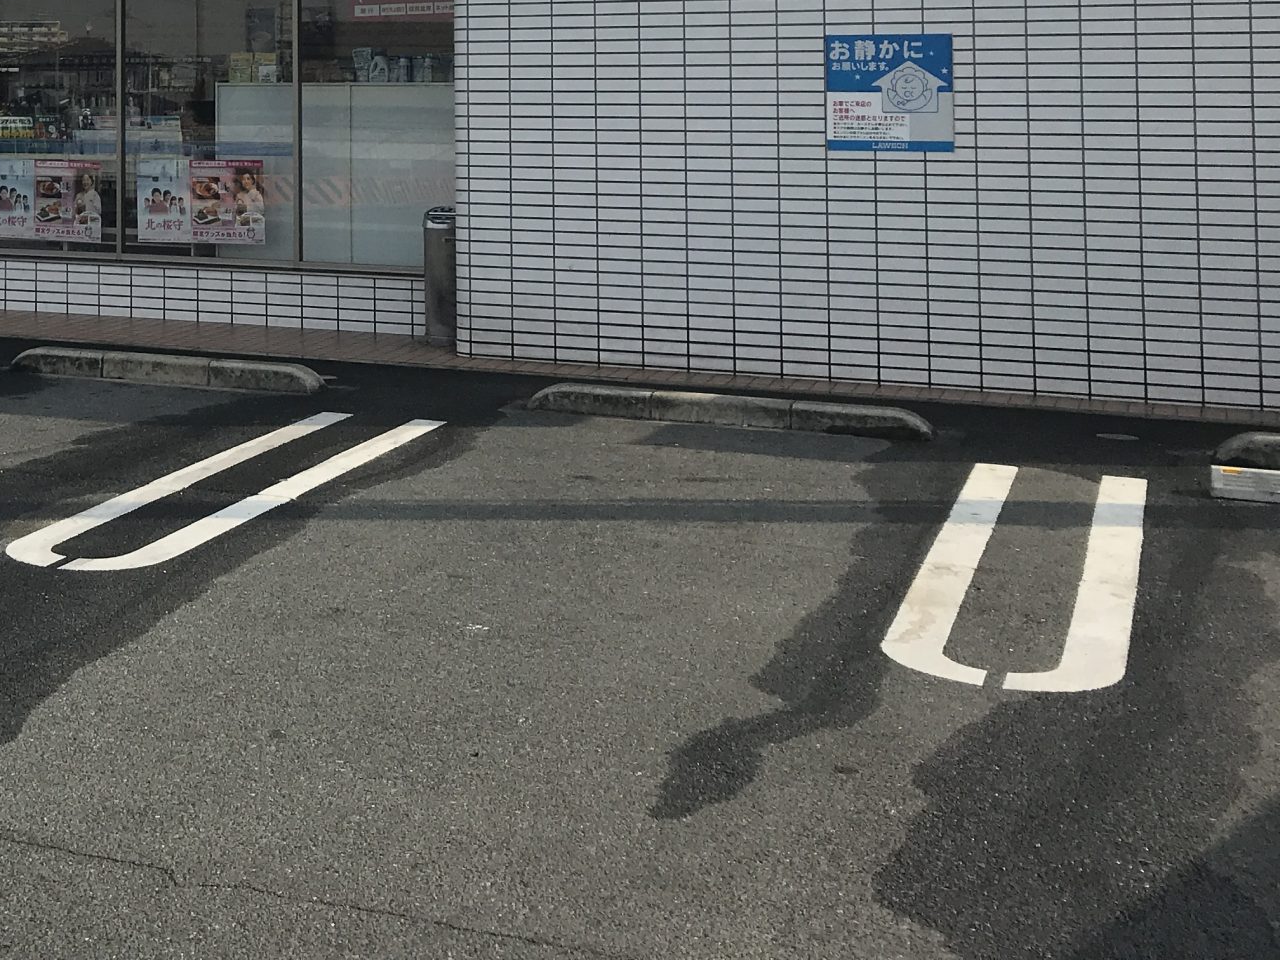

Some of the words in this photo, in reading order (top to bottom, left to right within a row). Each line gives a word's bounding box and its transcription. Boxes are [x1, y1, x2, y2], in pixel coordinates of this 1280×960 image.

[829, 39, 924, 61] お静かに
[831, 61, 890, 72] お願いします。
[145, 218, 184, 231] 北の桜守
